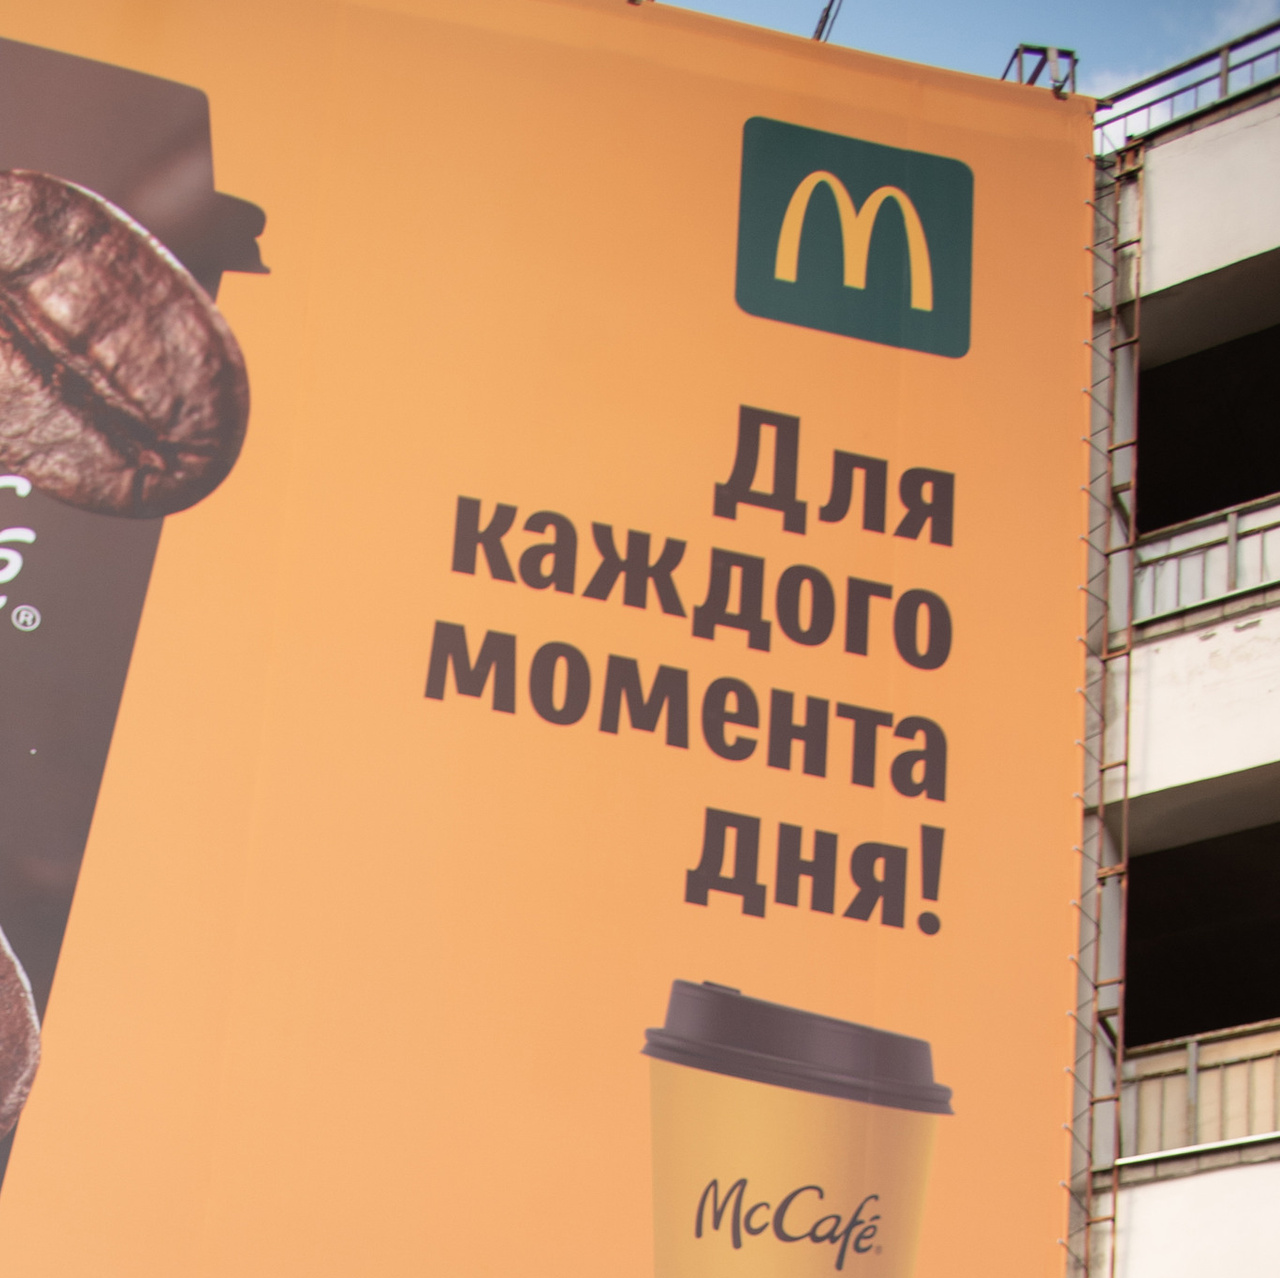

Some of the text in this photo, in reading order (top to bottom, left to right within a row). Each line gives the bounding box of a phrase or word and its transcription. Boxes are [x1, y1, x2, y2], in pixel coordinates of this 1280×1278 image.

[713, 404, 956, 547] Для
[450, 495, 955, 671] каждого
[424, 620, 949, 802] момента
[684, 807, 947, 937] дня!
